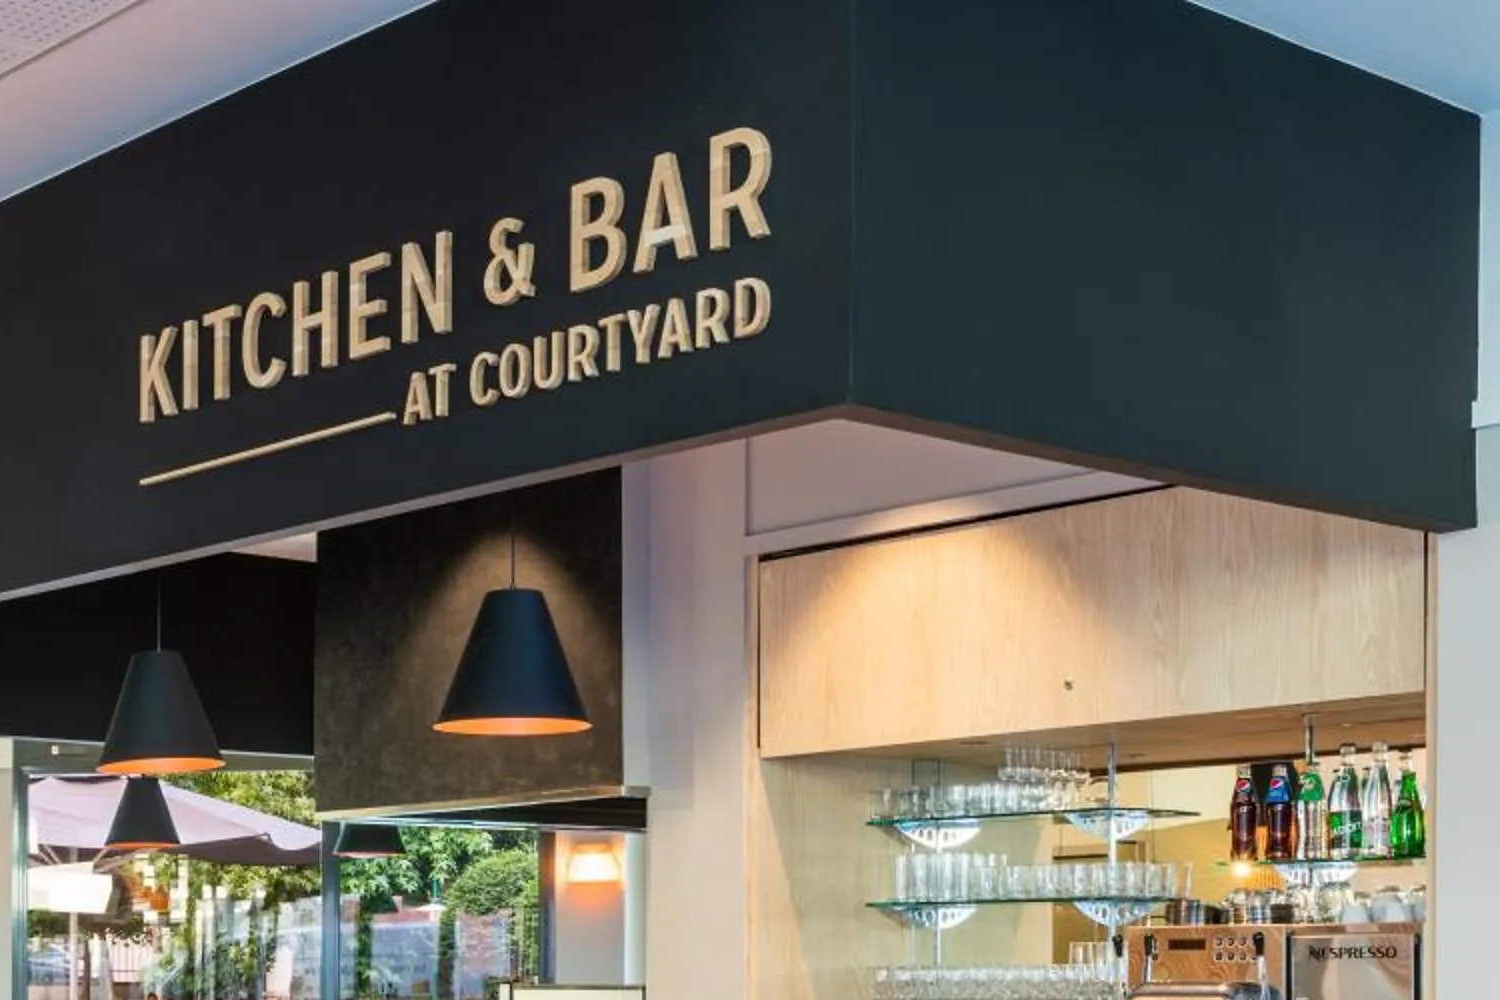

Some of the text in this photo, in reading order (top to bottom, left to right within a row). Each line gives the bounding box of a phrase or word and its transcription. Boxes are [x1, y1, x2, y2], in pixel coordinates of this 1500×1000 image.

[139, 127, 772, 423] KITCHEN & BAR
[402, 276, 772, 425] AT COURTYARD
[1308, 944, 1397, 961] NESPRESSO
